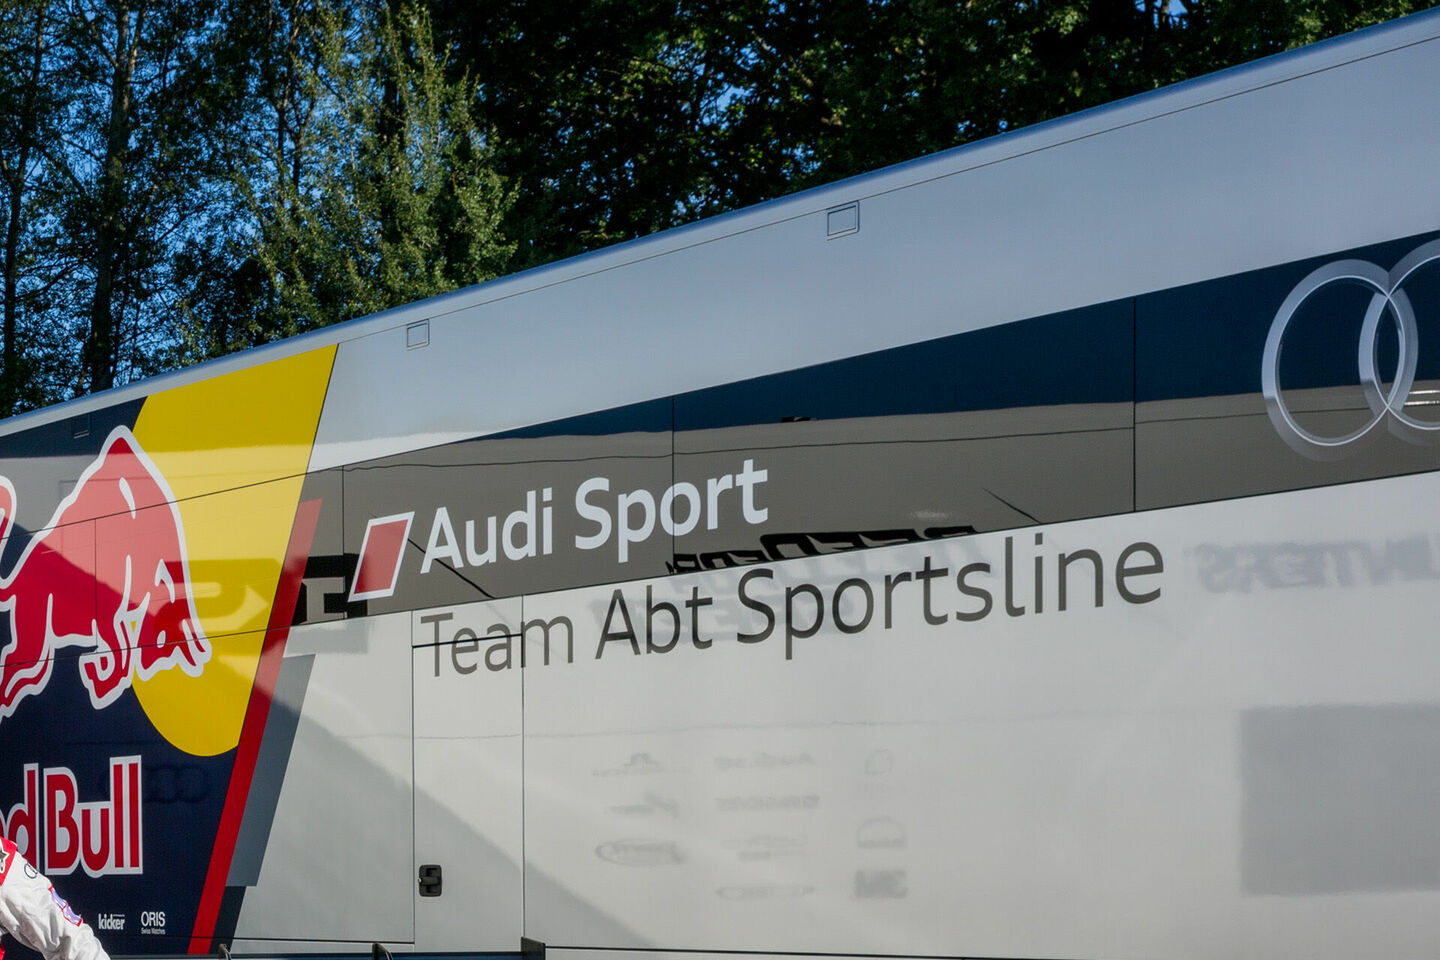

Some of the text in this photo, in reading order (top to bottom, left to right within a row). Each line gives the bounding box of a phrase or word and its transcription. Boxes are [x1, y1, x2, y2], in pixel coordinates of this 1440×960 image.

[420, 459, 768, 574] Audi Sport
[420, 612, 574, 677] Team
[595, 585, 713, 660] Abt
[737, 533, 1164, 661] Sportsline
[44, 754, 143, 878] Bull
[98, 913, 125, 930] kicker
[140, 911, 166, 927] ORIS
